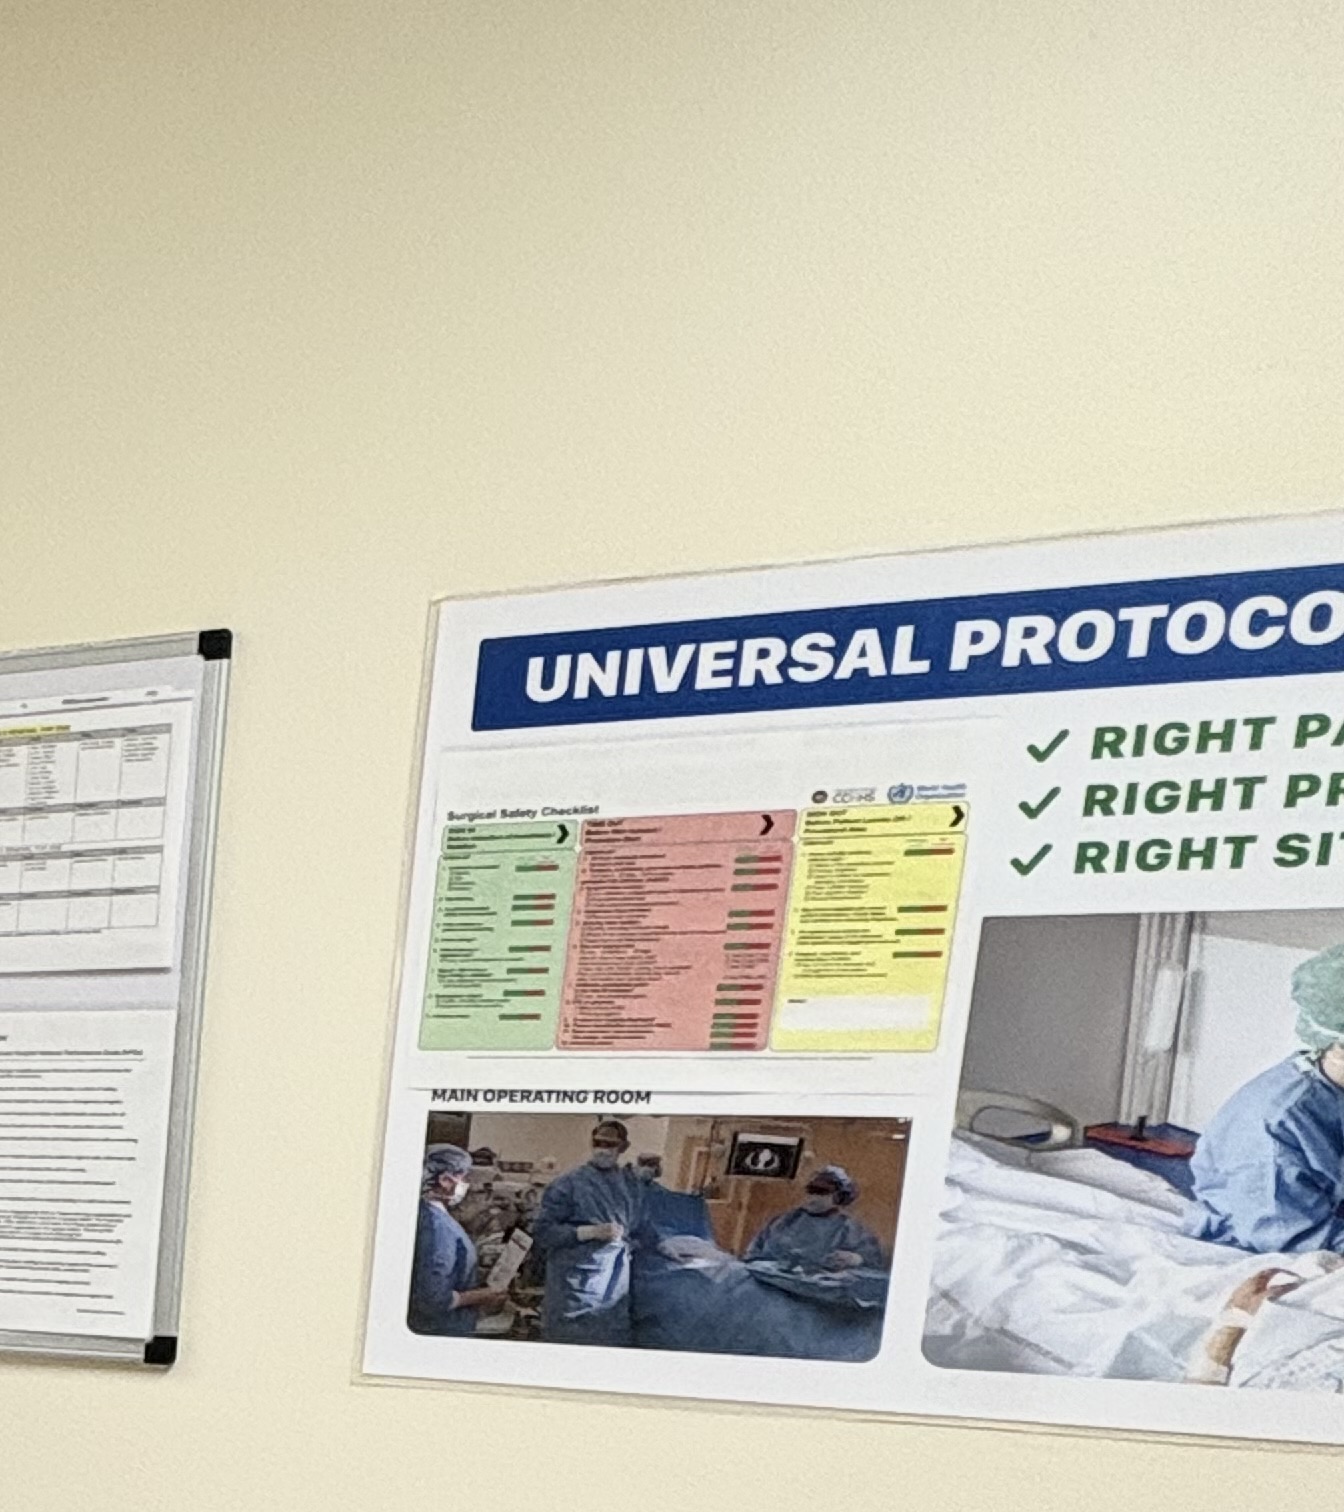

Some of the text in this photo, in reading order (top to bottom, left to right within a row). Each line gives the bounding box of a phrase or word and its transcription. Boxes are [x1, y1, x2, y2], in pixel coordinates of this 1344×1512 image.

[525, 590, 1344, 703] UNIVERSAL PROTOCO
[1090, 716, 1277, 760] RIGHT
[446, 805, 600, 822] Surgical Safety Checklist
[1082, 775, 1268, 817] RIGHT
[1073, 831, 1344, 874] RIGHT SI
[431, 1088, 652, 1105] MAIN OPERATING ROOM
